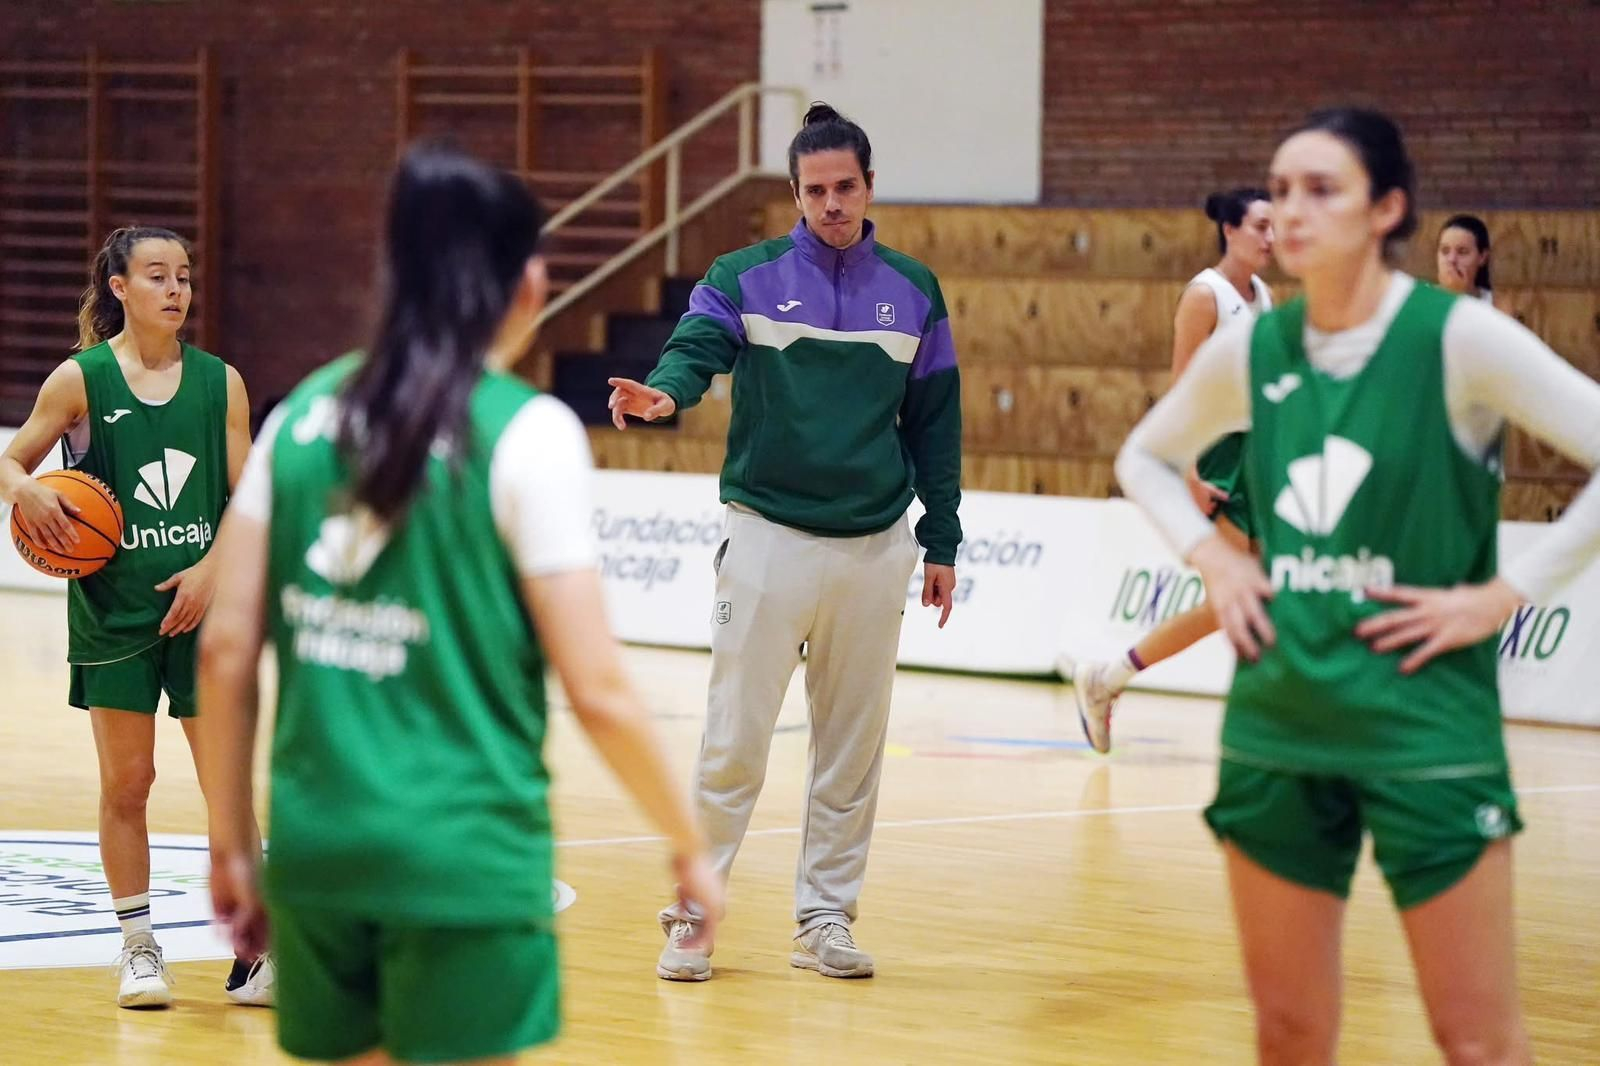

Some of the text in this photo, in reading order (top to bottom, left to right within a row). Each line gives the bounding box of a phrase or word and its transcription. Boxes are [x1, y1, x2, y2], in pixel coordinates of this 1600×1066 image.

[120, 516, 212, 550] Unicaja
[15, 534, 81, 576] Wilson
[1270, 545, 1394, 604] nicaja
